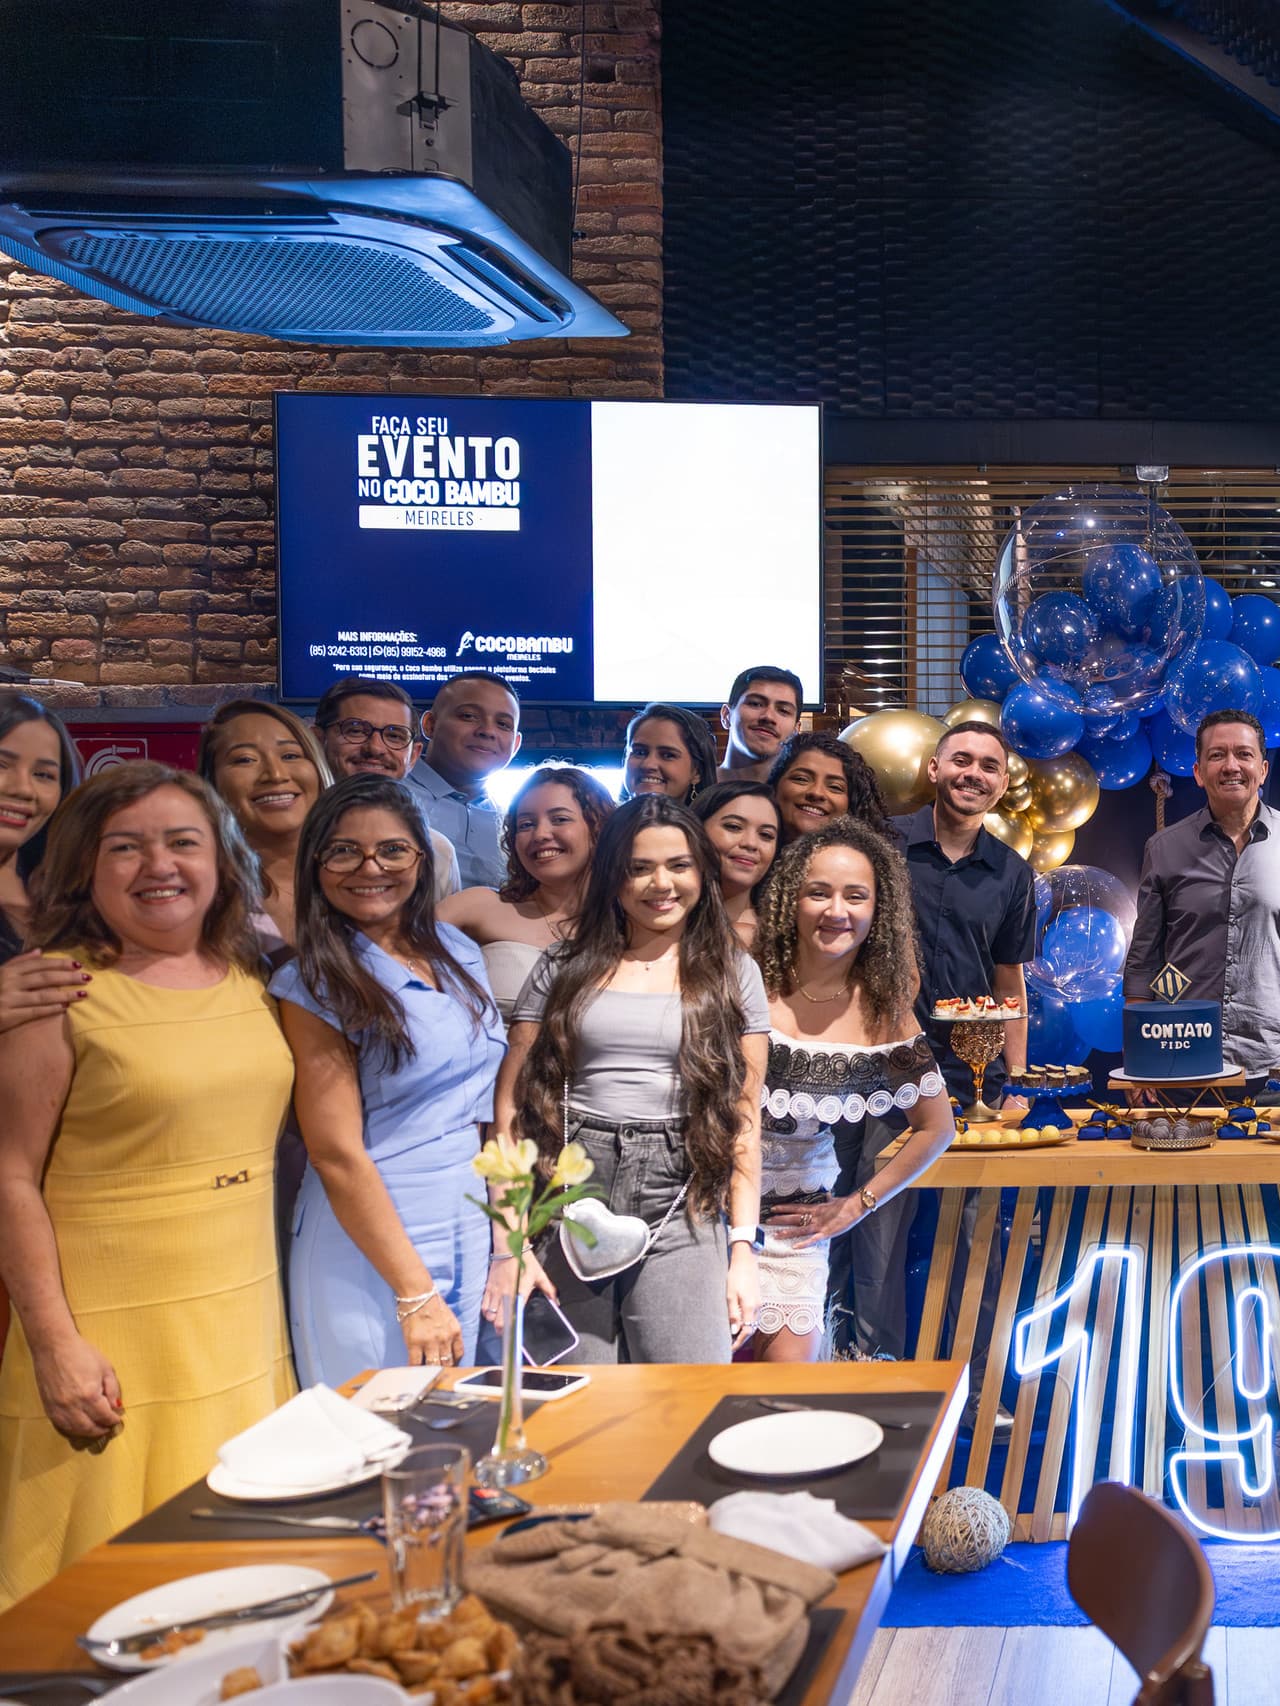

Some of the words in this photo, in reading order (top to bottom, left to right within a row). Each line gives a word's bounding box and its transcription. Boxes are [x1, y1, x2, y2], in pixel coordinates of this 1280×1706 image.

[372, 416, 411, 439] FAÇA
[416, 416, 448, 435] SEU
[358, 435, 520, 480] EVENTO
[358, 478, 381, 497] NO
[383, 479, 440, 505] COCO
[445, 481, 520, 506] BAMBU
[405, 510, 474, 526] MEIRELES
[338, 631, 359, 642] MAIS
[360, 630, 418, 645] INFORMAÇÕES:
[475, 636, 573, 653] COCOBAMBU
[310, 644, 326, 657] (85)
[384, 646, 400, 658] (85)
[1141, 1022, 1213, 1039] CONTATO
[1160, 1040, 1191, 1050] FIDC
